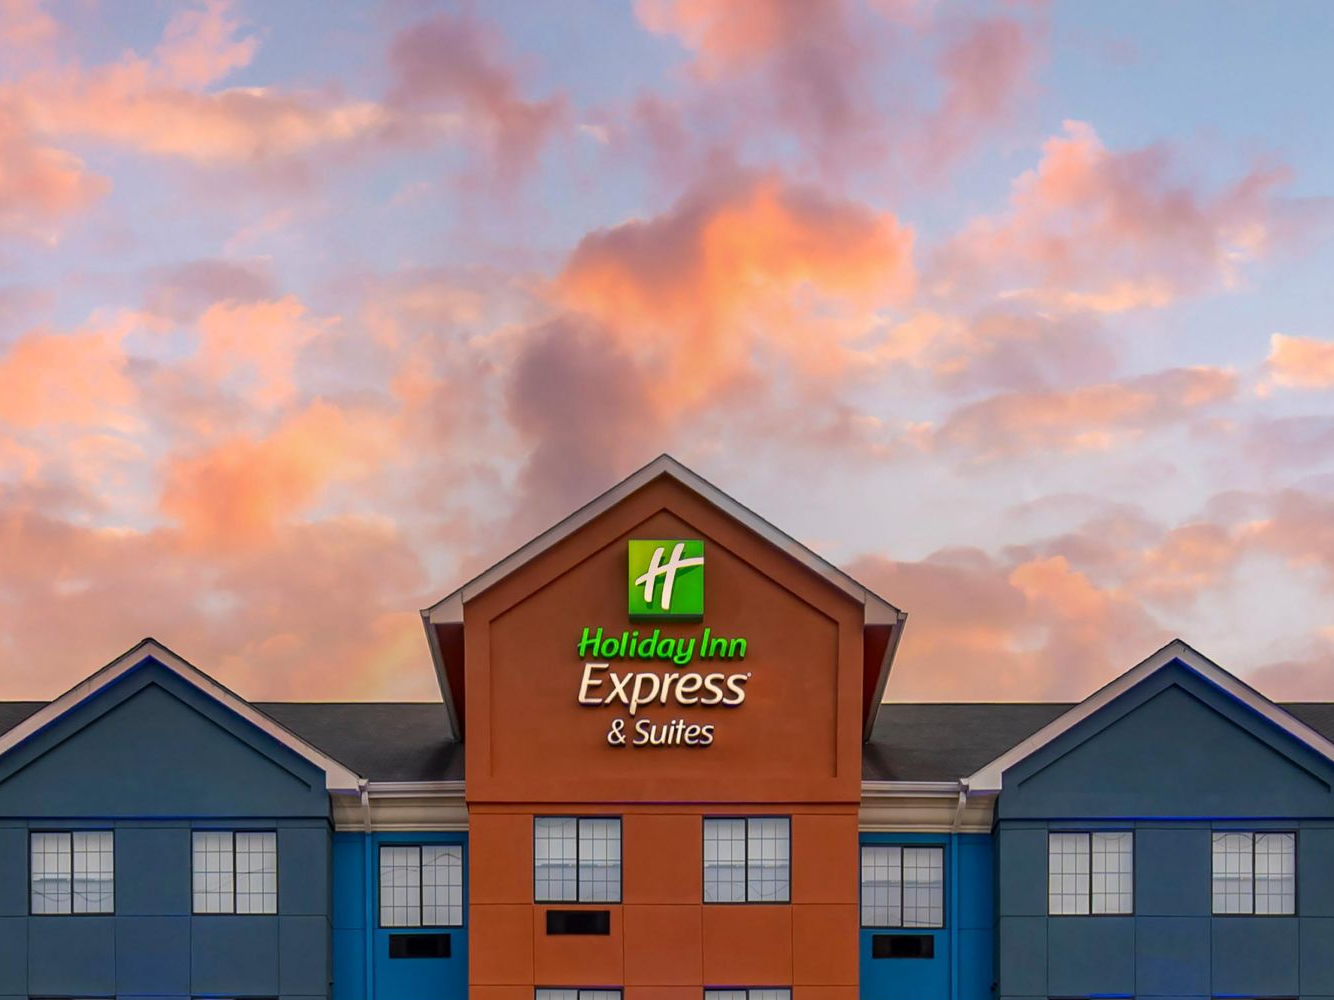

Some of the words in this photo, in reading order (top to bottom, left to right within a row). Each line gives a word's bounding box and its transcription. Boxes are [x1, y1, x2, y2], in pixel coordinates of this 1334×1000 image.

[578, 628, 695, 665] Holiday
[699, 628, 747, 658] Inn
[578, 662, 749, 715] Express
[607, 719, 626, 744] &
[633, 719, 714, 744] Suites
